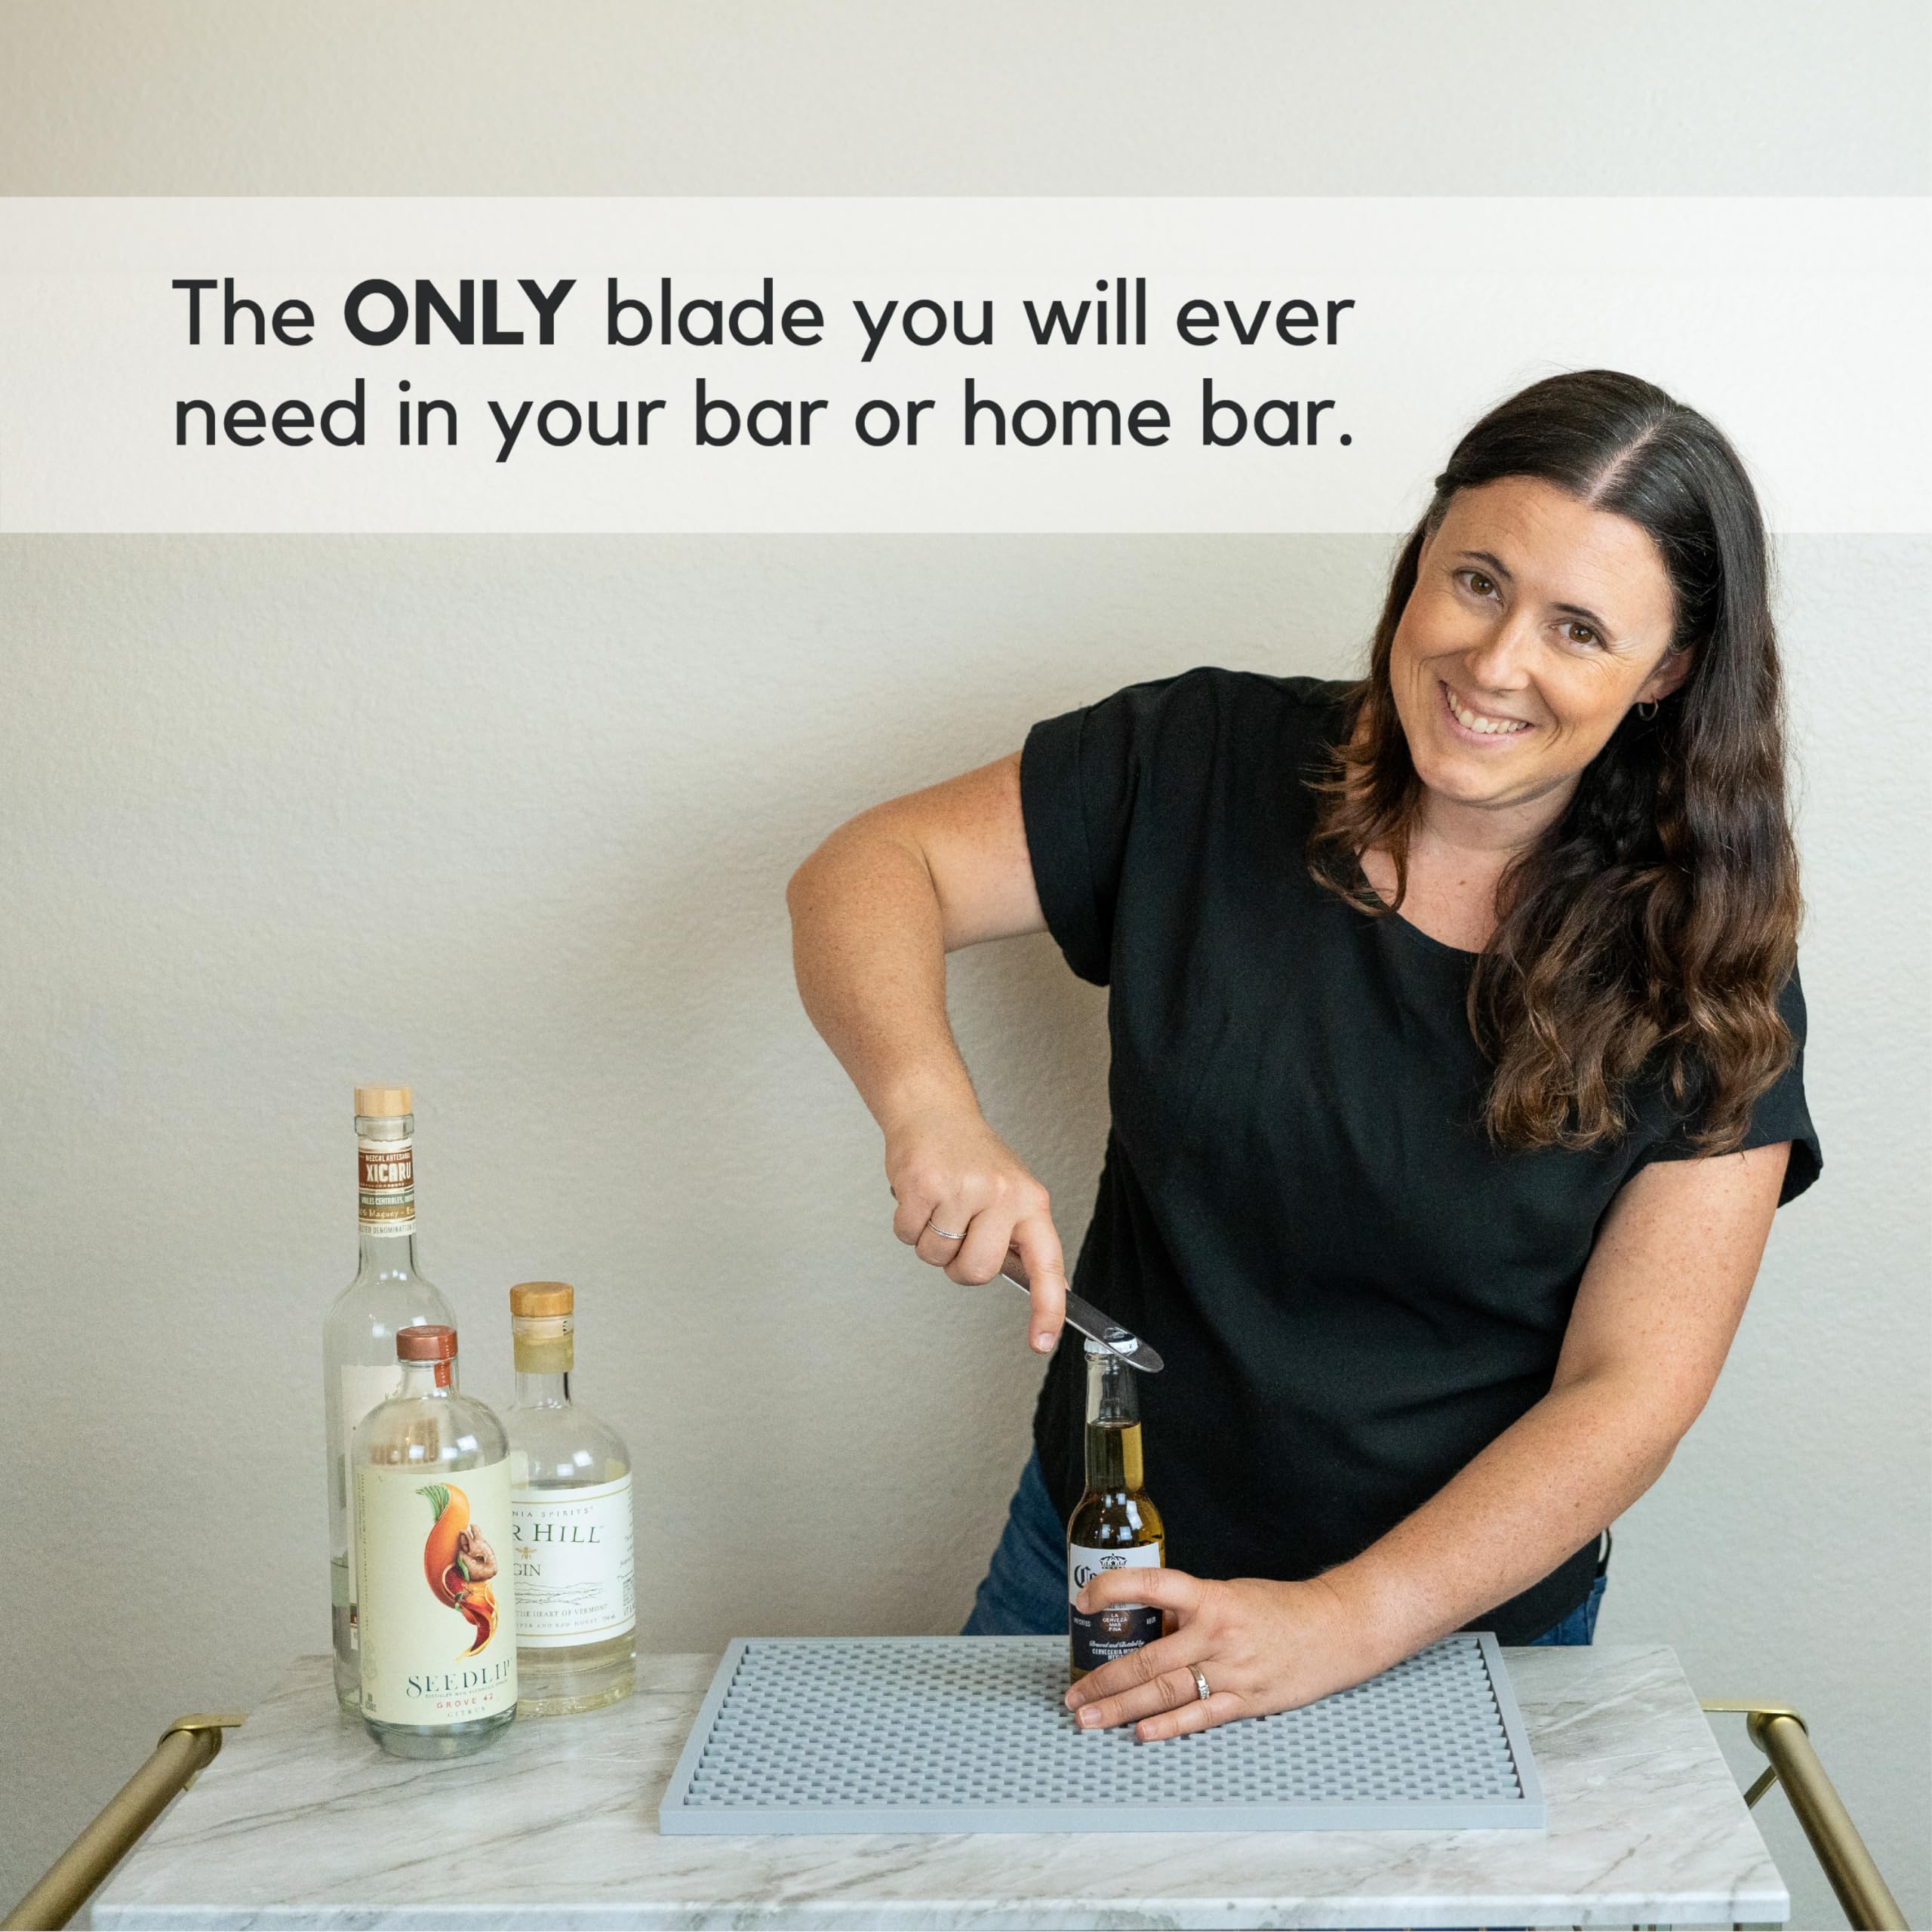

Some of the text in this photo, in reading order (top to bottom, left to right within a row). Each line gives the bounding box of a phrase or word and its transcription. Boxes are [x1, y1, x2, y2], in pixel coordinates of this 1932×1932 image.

[365, 1154, 386, 1162] MEZCAL
[365, 1161, 411, 1183] XICARU
[368, 1208, 398, 1219] Maguey
[514, 1564, 541, 1577] GIN
[574, 1604, 608, 1616] VERMONT
[406, 1659, 510, 1698] SEEDLIP
[436, 1693, 494, 1709] GROVE 42
[448, 1706, 485, 1718] CITRUS
